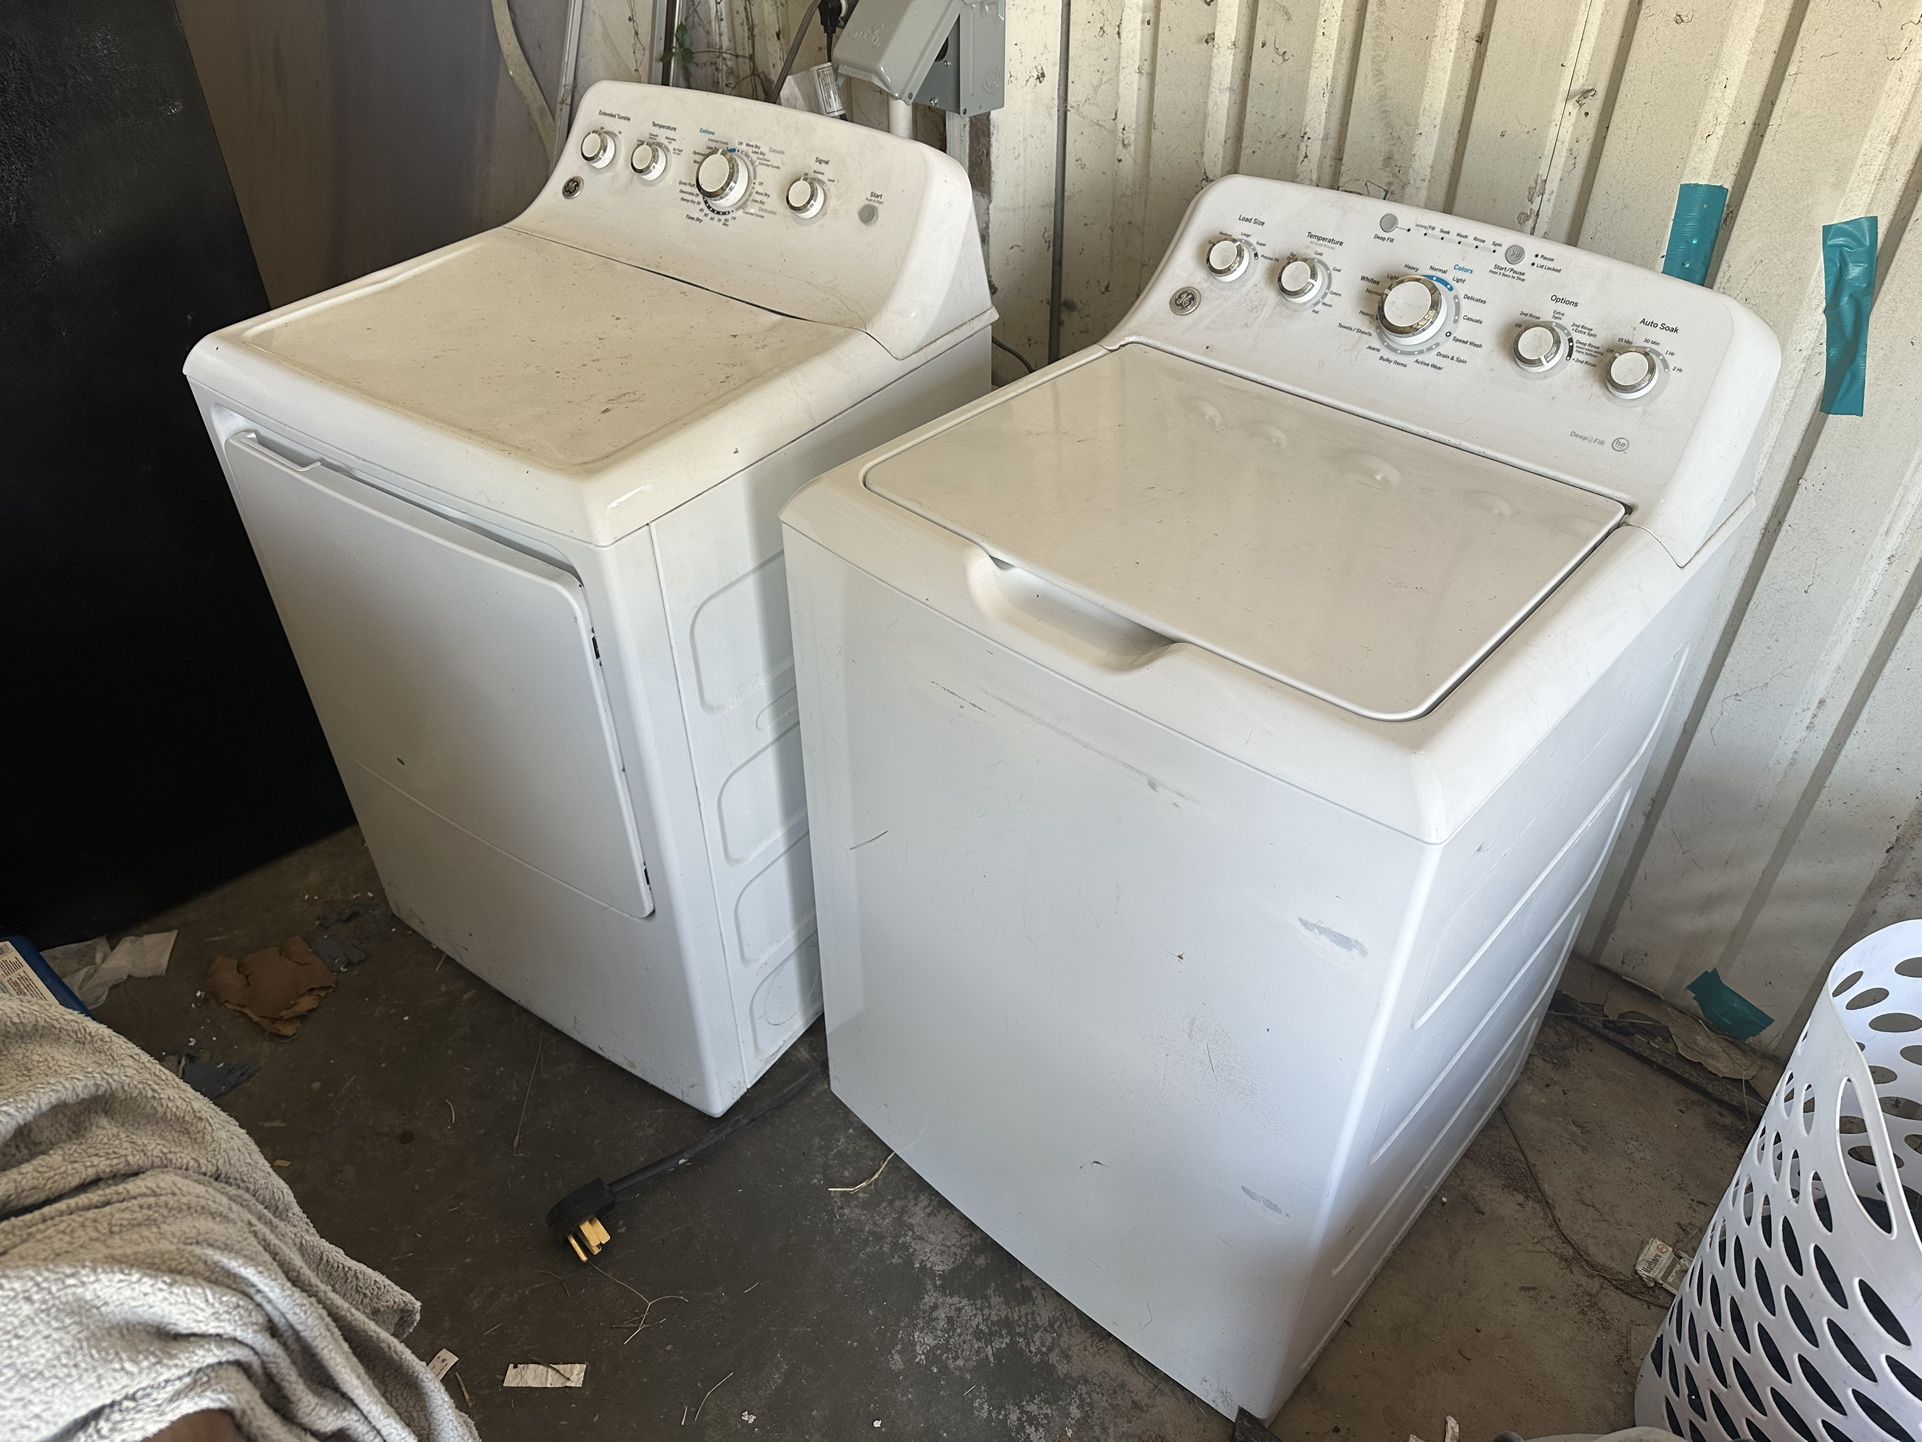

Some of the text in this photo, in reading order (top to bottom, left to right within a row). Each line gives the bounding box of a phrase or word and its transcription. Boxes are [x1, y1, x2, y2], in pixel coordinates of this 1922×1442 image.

[870, 191, 883, 199] Start
[1238, 214, 1265, 227] Load Size
[1307, 231, 1344, 247] Temperature
[1373, 233, 1386, 242] Deep
[1540, 254, 1554, 262] Pause
[1404, 263, 1419, 273] Heavy
[1429, 265, 1448, 275] Normal
[1453, 264, 1474, 275] Colors
[1494, 264, 1526, 277] Start/Pause
[1544, 265, 1562, 274] Locked
[1360, 275, 1380, 286] Whites
[1452, 275, 1466, 284] Light
[1463, 293, 1487, 304] Delicates
[1550, 294, 1579, 308] Options
[1462, 314, 1483, 325] Casuals
[1338, 322, 1354, 332] Towels
[1356, 328, 1372, 337] Sheets
[1639, 318, 1680, 335] Auto Soak
[1452, 336, 1483, 349] Speed Wash
[1366, 344, 1381, 353] Jeans
[1379, 355, 1407, 368] Bulky Items
[1414, 358, 1430, 367] Active
[1436, 351, 1450, 360] Drain
[1455, 356, 1468, 365] Spin
[1569, 430, 1606, 446] Deep Fill
